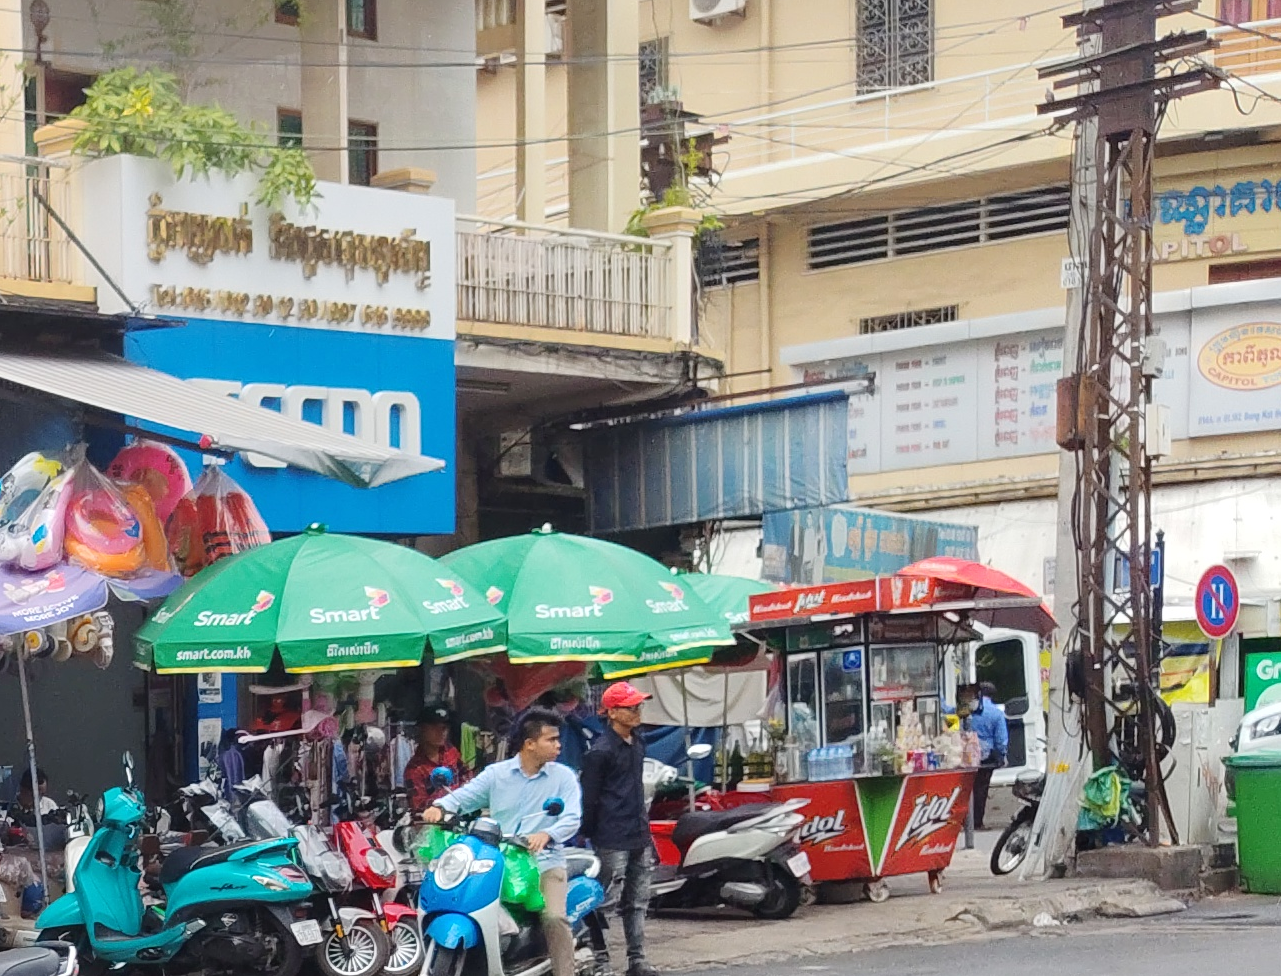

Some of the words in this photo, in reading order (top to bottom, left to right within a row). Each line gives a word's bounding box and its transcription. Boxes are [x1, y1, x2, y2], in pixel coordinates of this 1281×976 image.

[1208, 367, 1259, 386] CAPITOL
[12, 606, 42, 618] MORE
[310, 604, 381, 624] Smart
[423, 595, 469, 615] Smart
[535, 602, 604, 619] Smart
[645, 596, 689, 614] Smart
[24, 612, 53, 623] MORE
[194, 609, 255, 627] Smart
[445, 627, 494, 648] smart.com.kh
[176, 646, 252, 661] smart.com.kh
